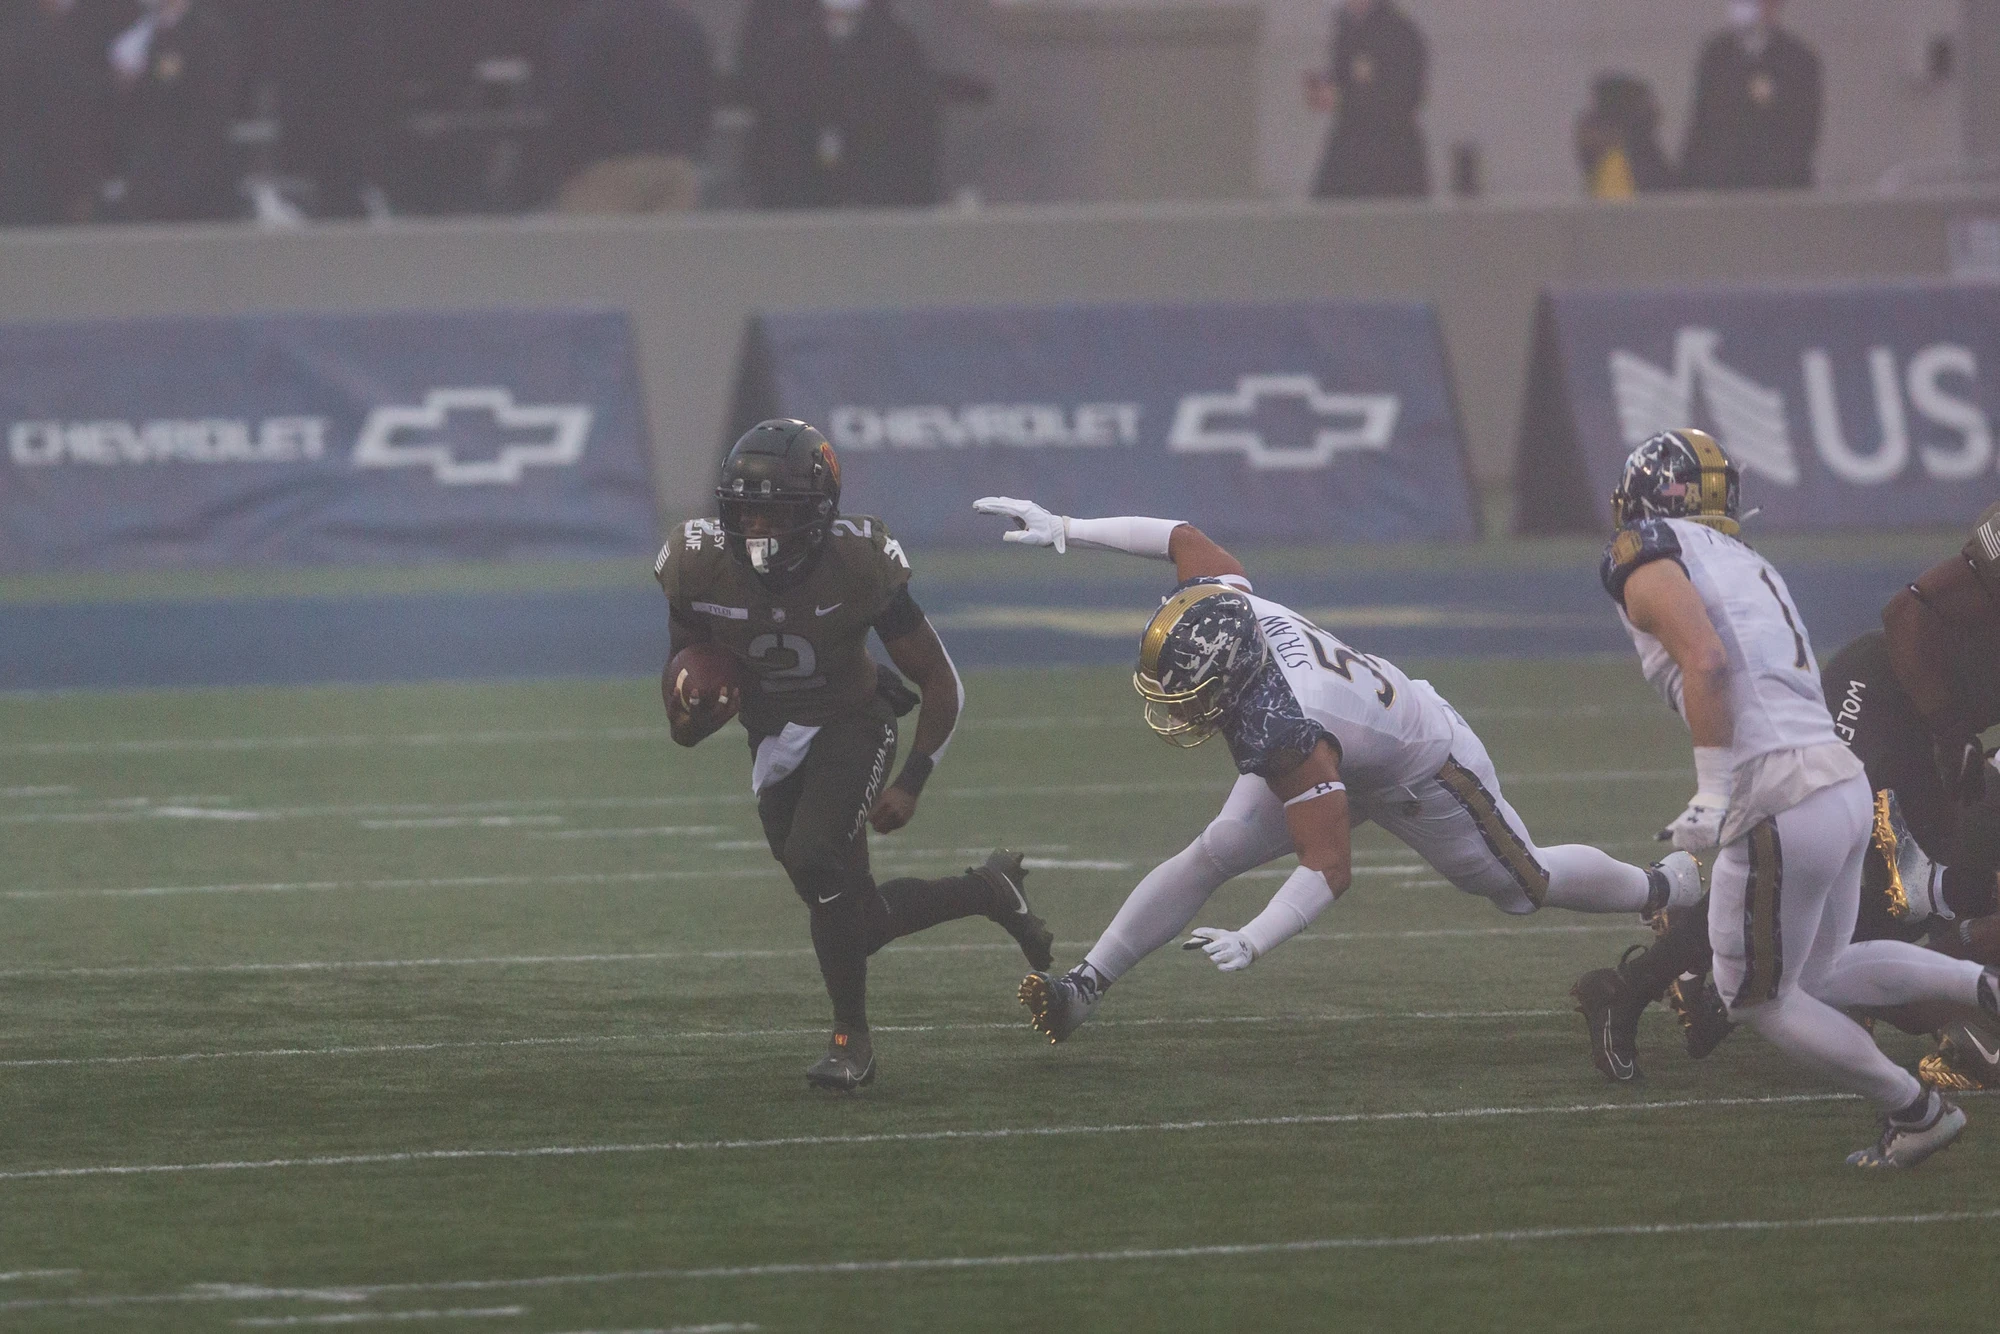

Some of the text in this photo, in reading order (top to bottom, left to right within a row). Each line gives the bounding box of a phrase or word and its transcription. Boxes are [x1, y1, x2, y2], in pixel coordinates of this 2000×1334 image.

[8, 415, 330, 465] CHEVROLET
[828, 401, 1140, 449] CHEVROLET
[1804, 342, 2000, 486] US
[1258, 615, 1313, 670] STRAW
[1758, 566, 1812, 674] 1
[748, 633, 828, 693] 2
[1836, 680, 1867, 746] WOLF
